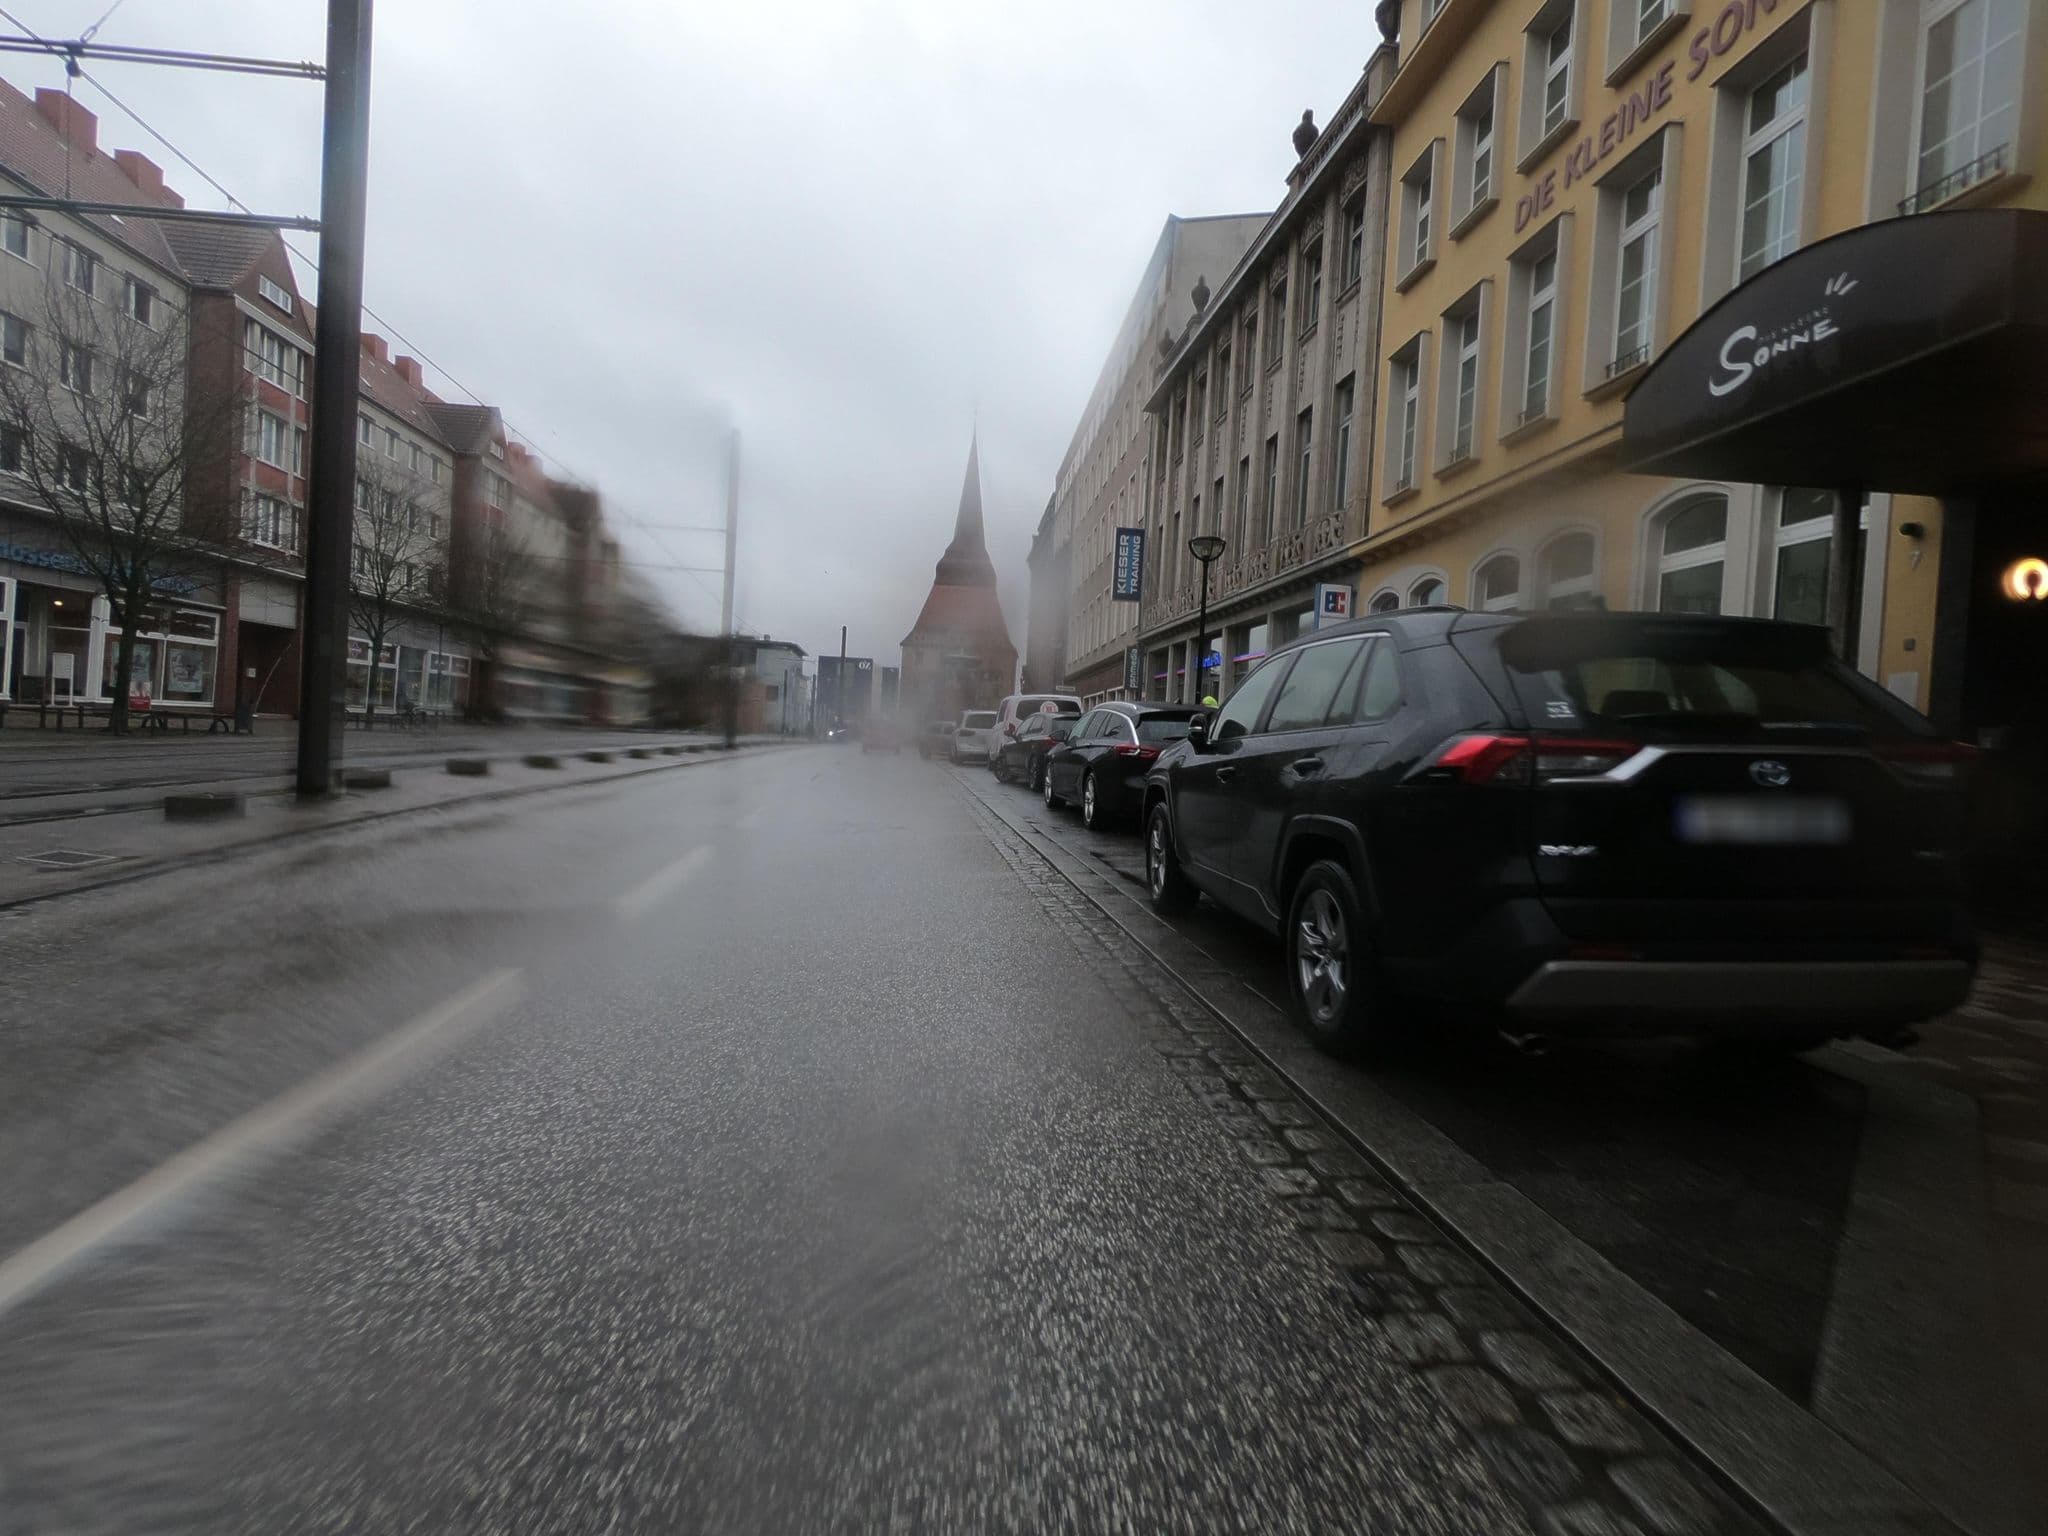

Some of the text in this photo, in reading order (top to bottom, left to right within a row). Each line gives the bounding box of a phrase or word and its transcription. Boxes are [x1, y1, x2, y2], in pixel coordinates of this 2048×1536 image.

[1514, 168, 1556, 233] DIE
[1564, 60, 1676, 189] KLEINE
[1116, 533, 1130, 595] KIESER
[1130, 535, 1142, 594] TRAINING
